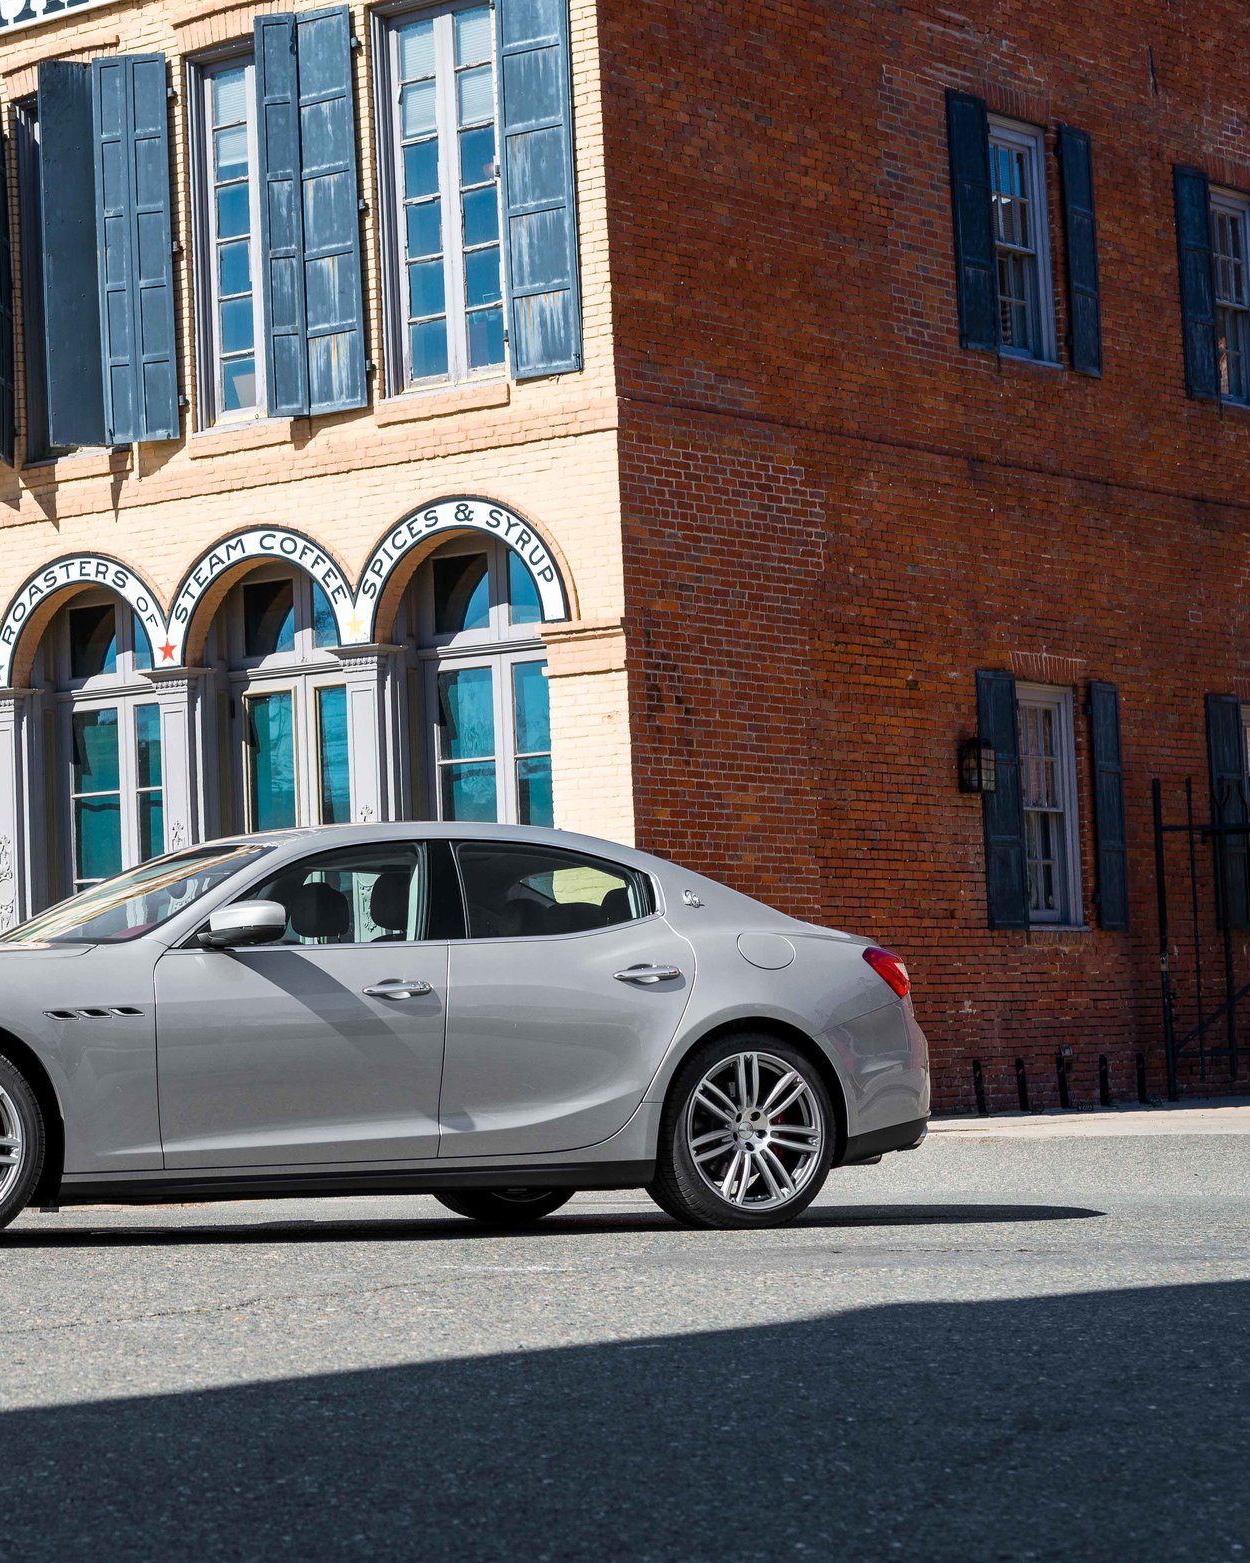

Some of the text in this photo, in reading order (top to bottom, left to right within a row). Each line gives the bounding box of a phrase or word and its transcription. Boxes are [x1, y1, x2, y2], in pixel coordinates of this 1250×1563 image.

[175, 533, 348, 624] STEAM COFFEE
[362, 503, 554, 600] SPICES & SYRUP
[1, 561, 159, 645] ROASTERS OF
